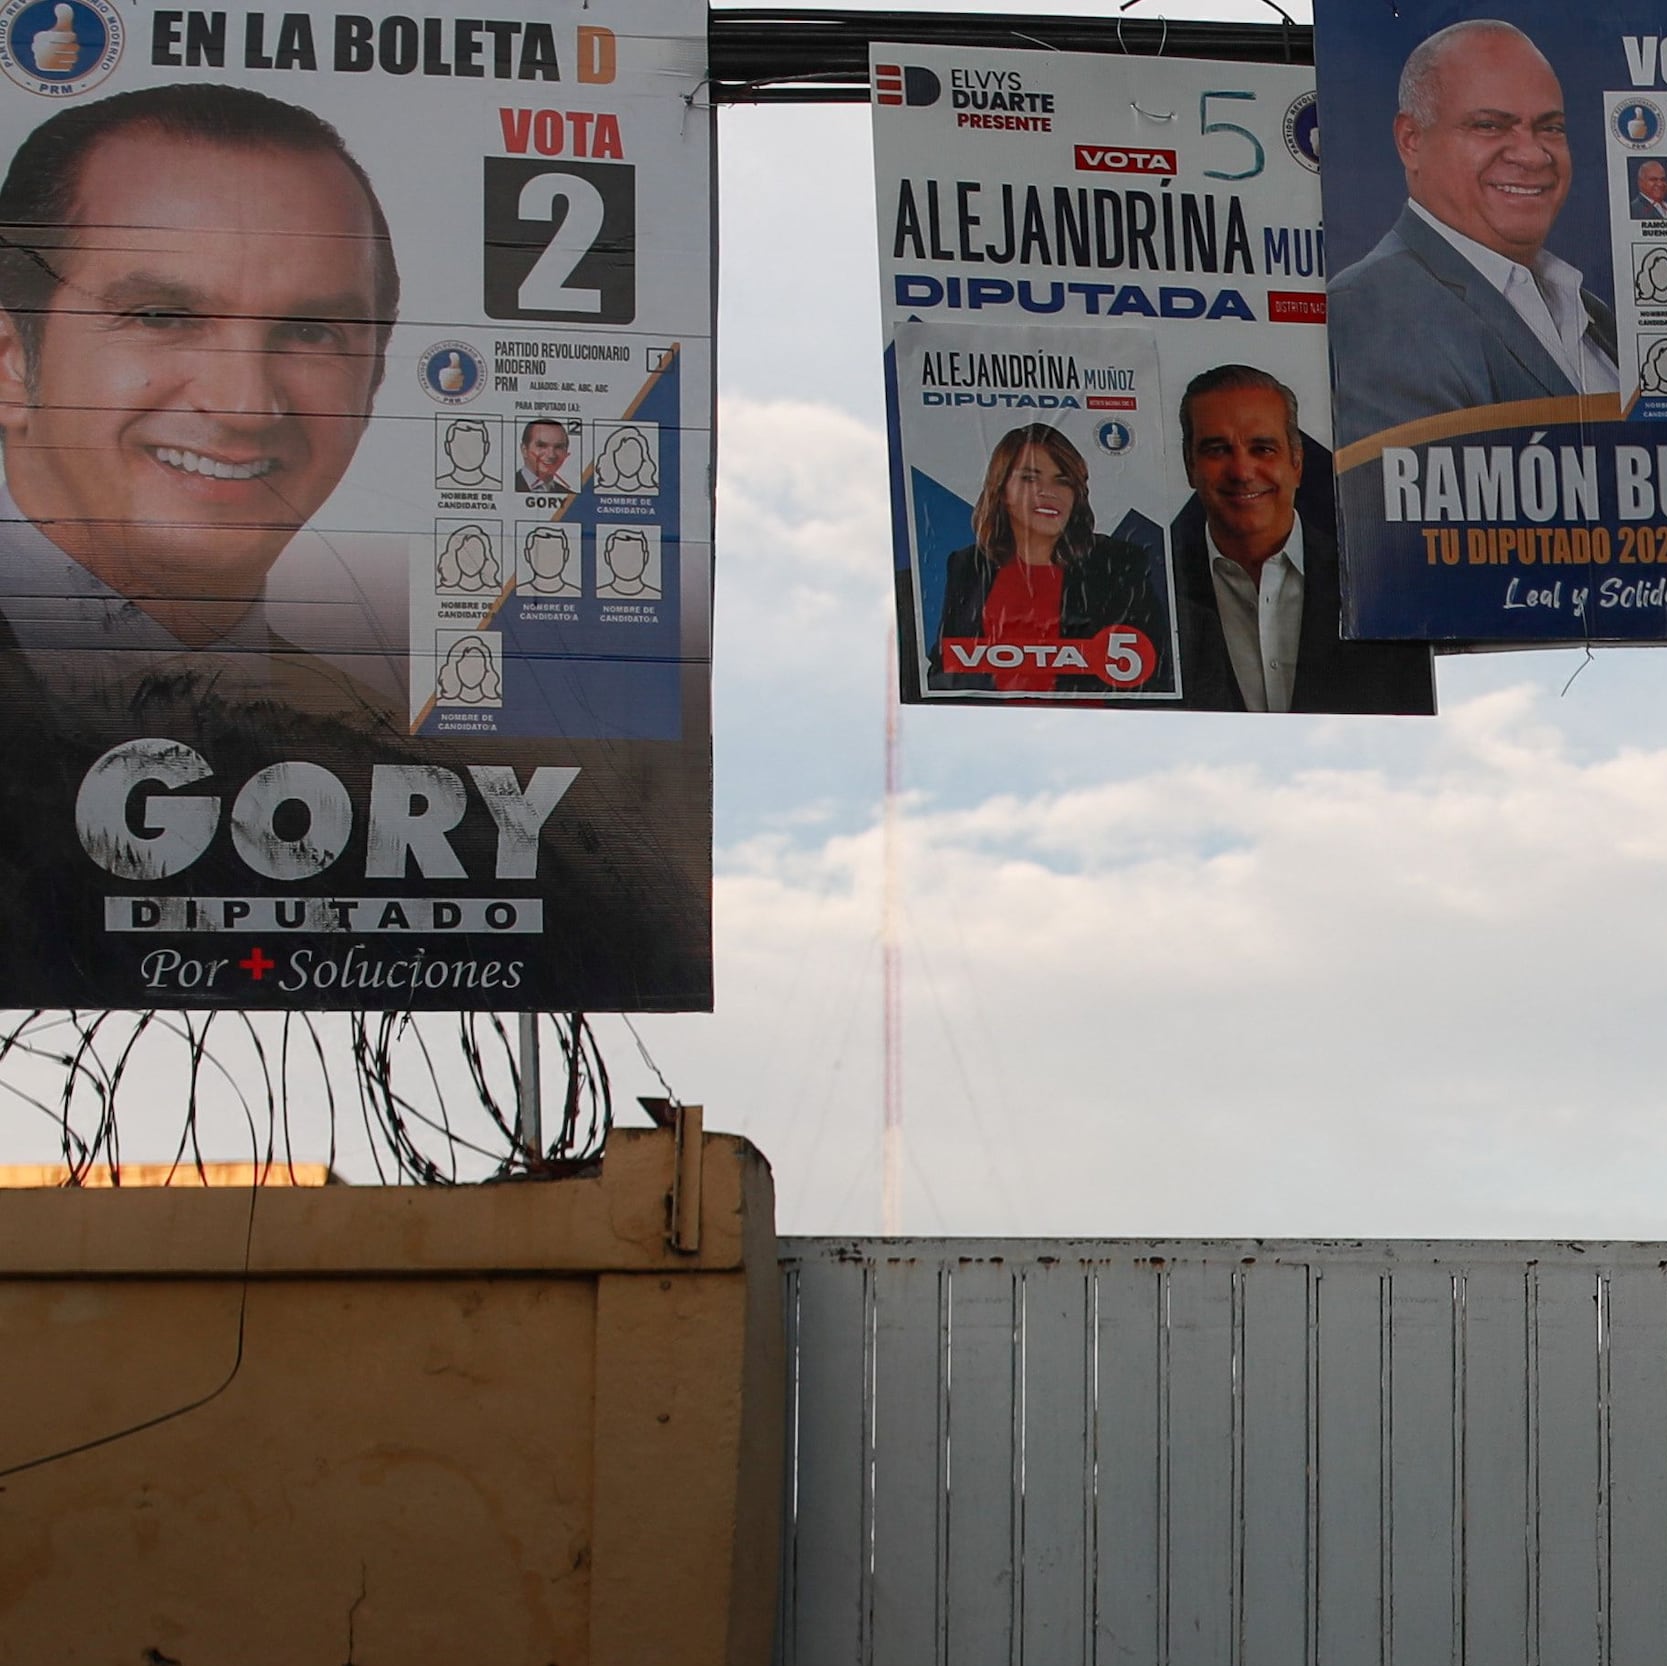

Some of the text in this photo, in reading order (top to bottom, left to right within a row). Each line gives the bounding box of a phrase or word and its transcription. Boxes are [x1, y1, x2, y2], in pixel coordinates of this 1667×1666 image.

[152, 11, 617, 85] EN LA BOLETA D
[952, 69, 1021, 91] ELVYS
[952, 92, 1054, 114] DUARTE
[957, 113, 1052, 132] PRESENTE
[499, 108, 624, 160] VOTA
[1201, 90, 1265, 181] 5
[1080, 149, 1171, 169] VOTA
[518, 173, 605, 313] 2
[894, 178, 1254, 275] ALEJANDRÍNA
[894, 275, 1256, 322] DIPUTADA
[495, 341, 630, 361] PARTIDO REVOLUCIONARIO
[495, 359, 546, 375] MODERNO
[922, 349, 1135, 391] ALEJANDRÍNA MUÑOZ
[495, 377, 518, 392] PRM
[922, 391, 1081, 409] DIPUTADA
[1382, 431, 1600, 523] RAMÓN
[525, 497, 566, 509] GORY
[1422, 528, 1459, 565] TU
[1468, 527, 1610, 565] DIPUTADO
[1503, 577, 1561, 610] Leal
[1572, 588, 1588, 617] y
[950, 632, 1143, 682] VOTA 5
[75, 738, 582, 880] GORY
[130, 901, 518, 930] DIPUTADO
[140, 945, 524, 991] Por Soluciones
